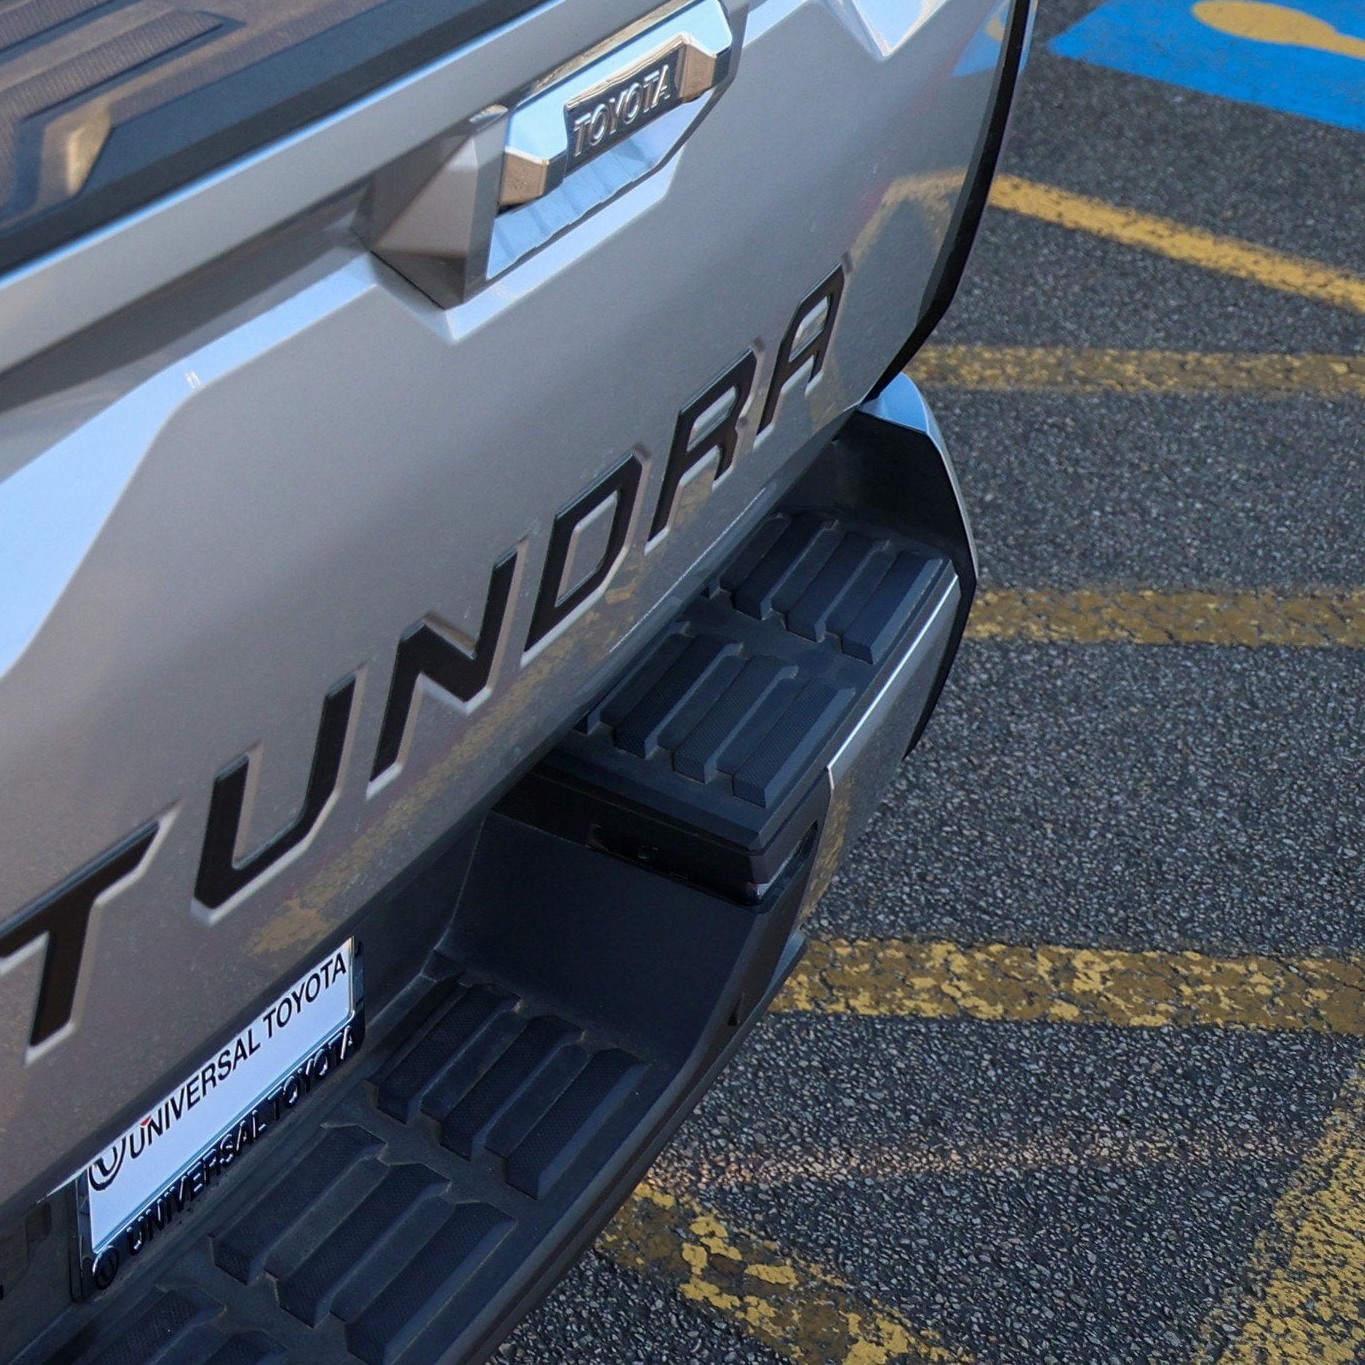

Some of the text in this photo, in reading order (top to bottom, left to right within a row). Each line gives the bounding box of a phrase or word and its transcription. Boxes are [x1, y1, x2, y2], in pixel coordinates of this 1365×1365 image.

[573, 63, 671, 158] TOYOTA
[127, 1110, 267, 1254] UNIVERSAL
[268, 1026, 357, 1121] TOYOTA
[130, 952, 347, 1161] UNIVERSAL TOYOTA
